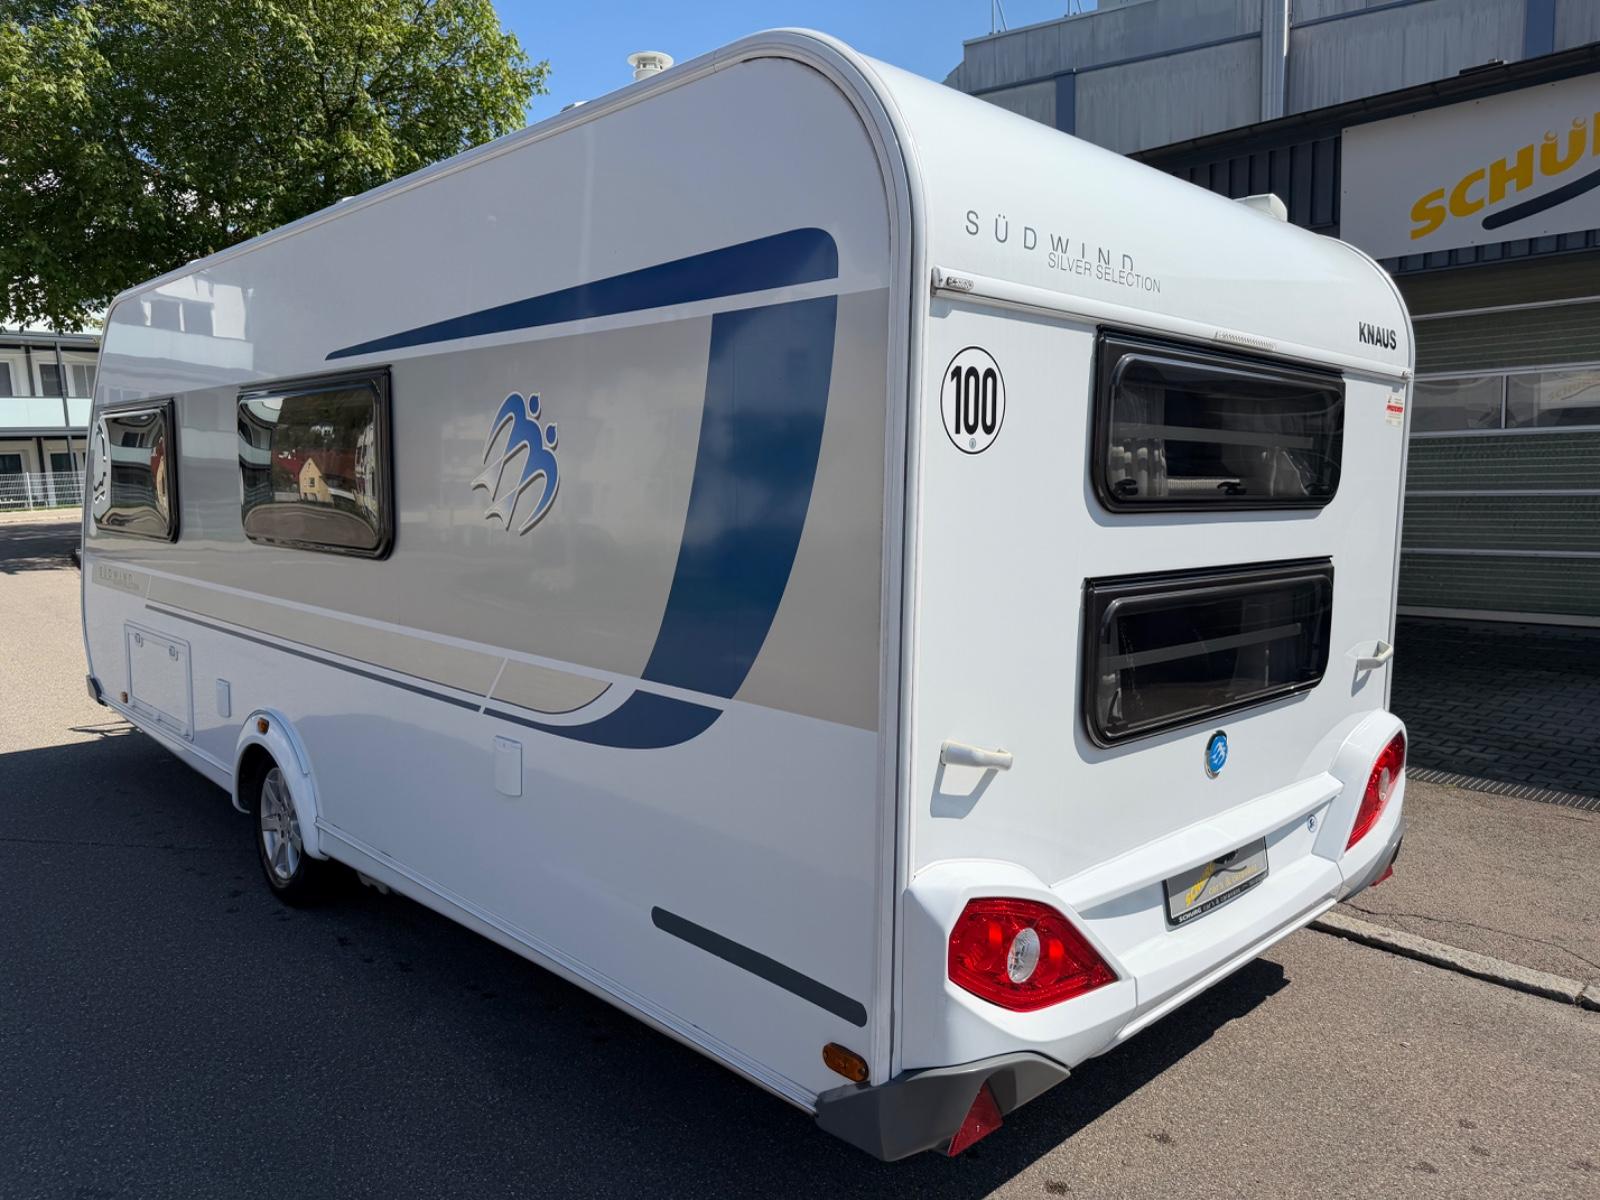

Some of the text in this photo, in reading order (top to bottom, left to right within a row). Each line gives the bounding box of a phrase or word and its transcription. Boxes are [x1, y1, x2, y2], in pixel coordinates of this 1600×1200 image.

[965, 210, 1135, 272] SÜDWIND
[1048, 252, 1161, 293] SILVER SELECTION
[1358, 321, 1397, 350] KNAUS
[950, 364, 998, 436] 100
